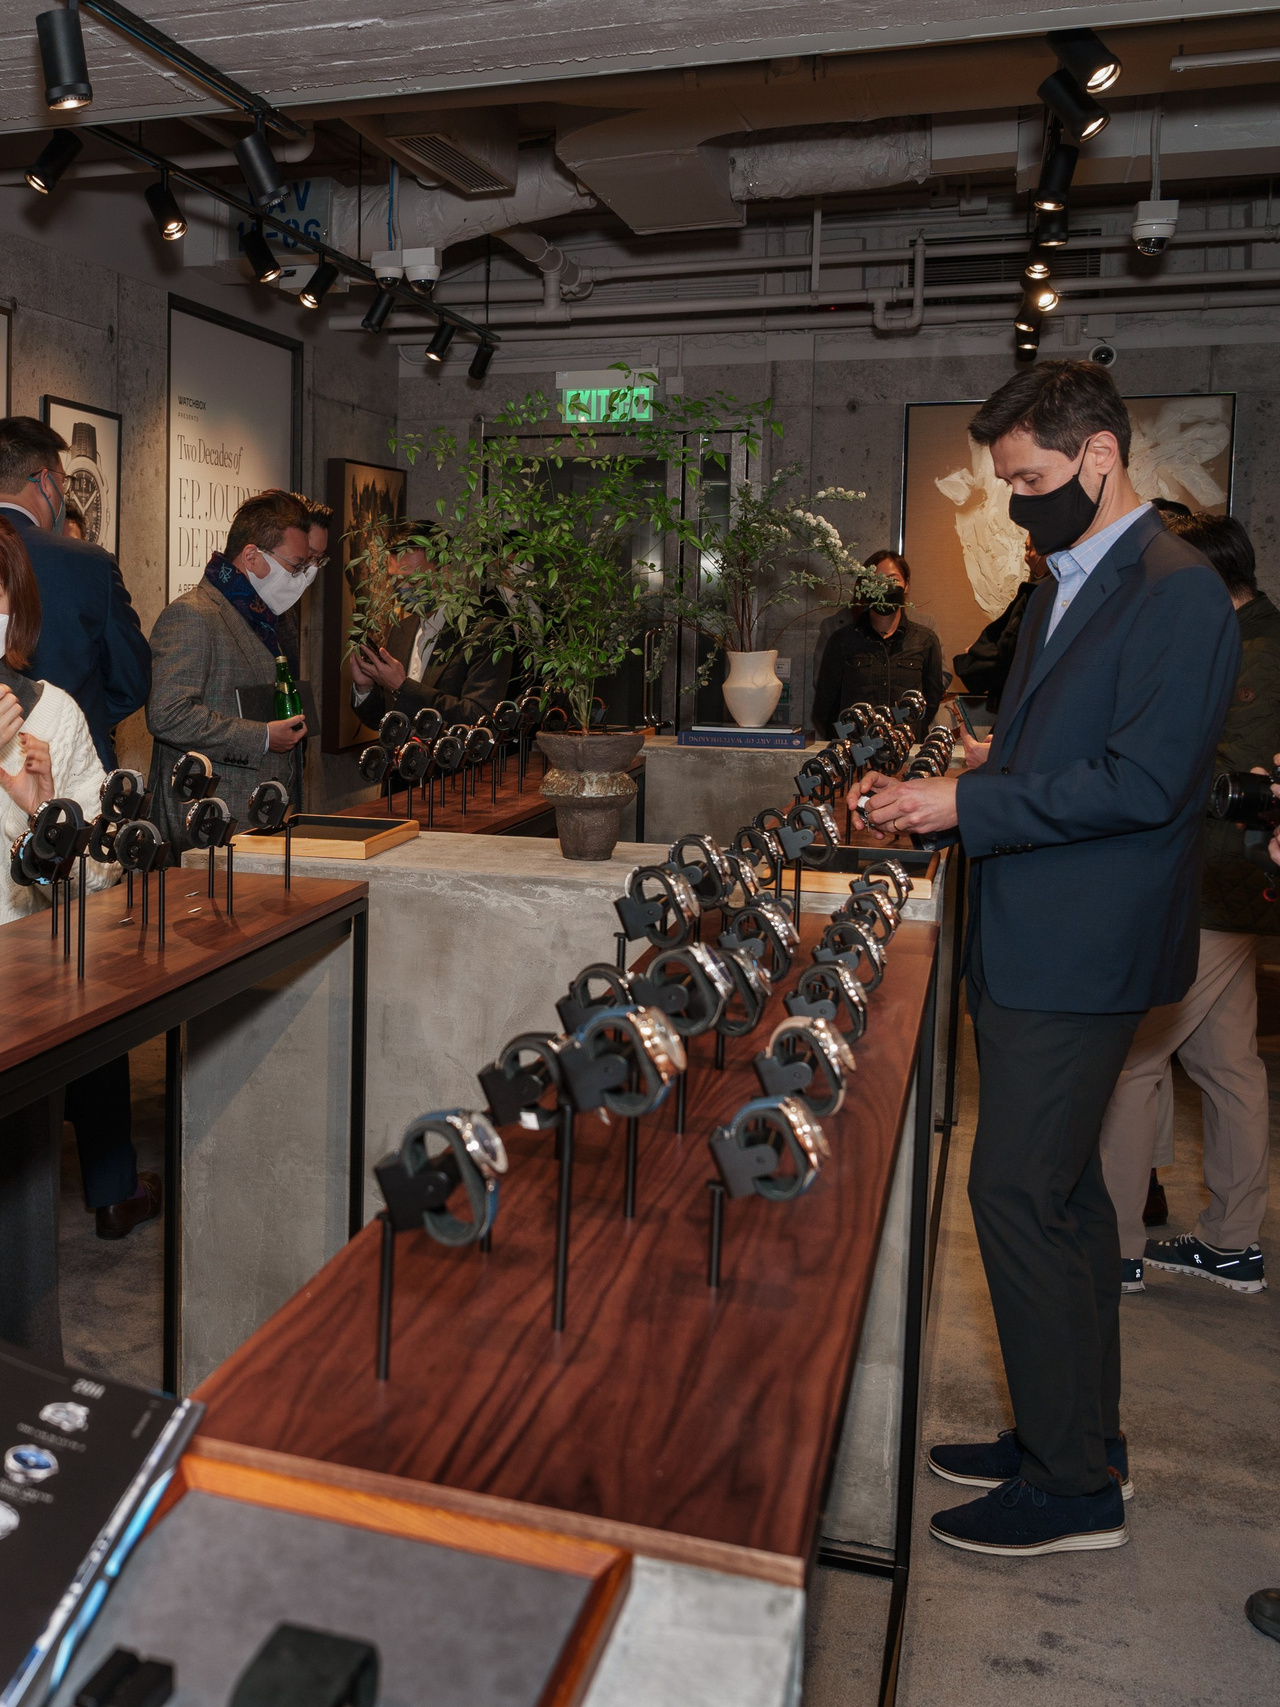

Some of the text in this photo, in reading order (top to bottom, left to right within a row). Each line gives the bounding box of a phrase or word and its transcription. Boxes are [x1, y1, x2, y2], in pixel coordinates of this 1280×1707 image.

[178, 395, 207, 411] WATCHBOX
[178, 411, 199, 422] PRESENTS
[566, 389, 610, 420] EXIT
[177, 434, 244, 475] Two Decades of
[179, 477, 201, 520] F.P.
[179, 526, 200, 568] DE
